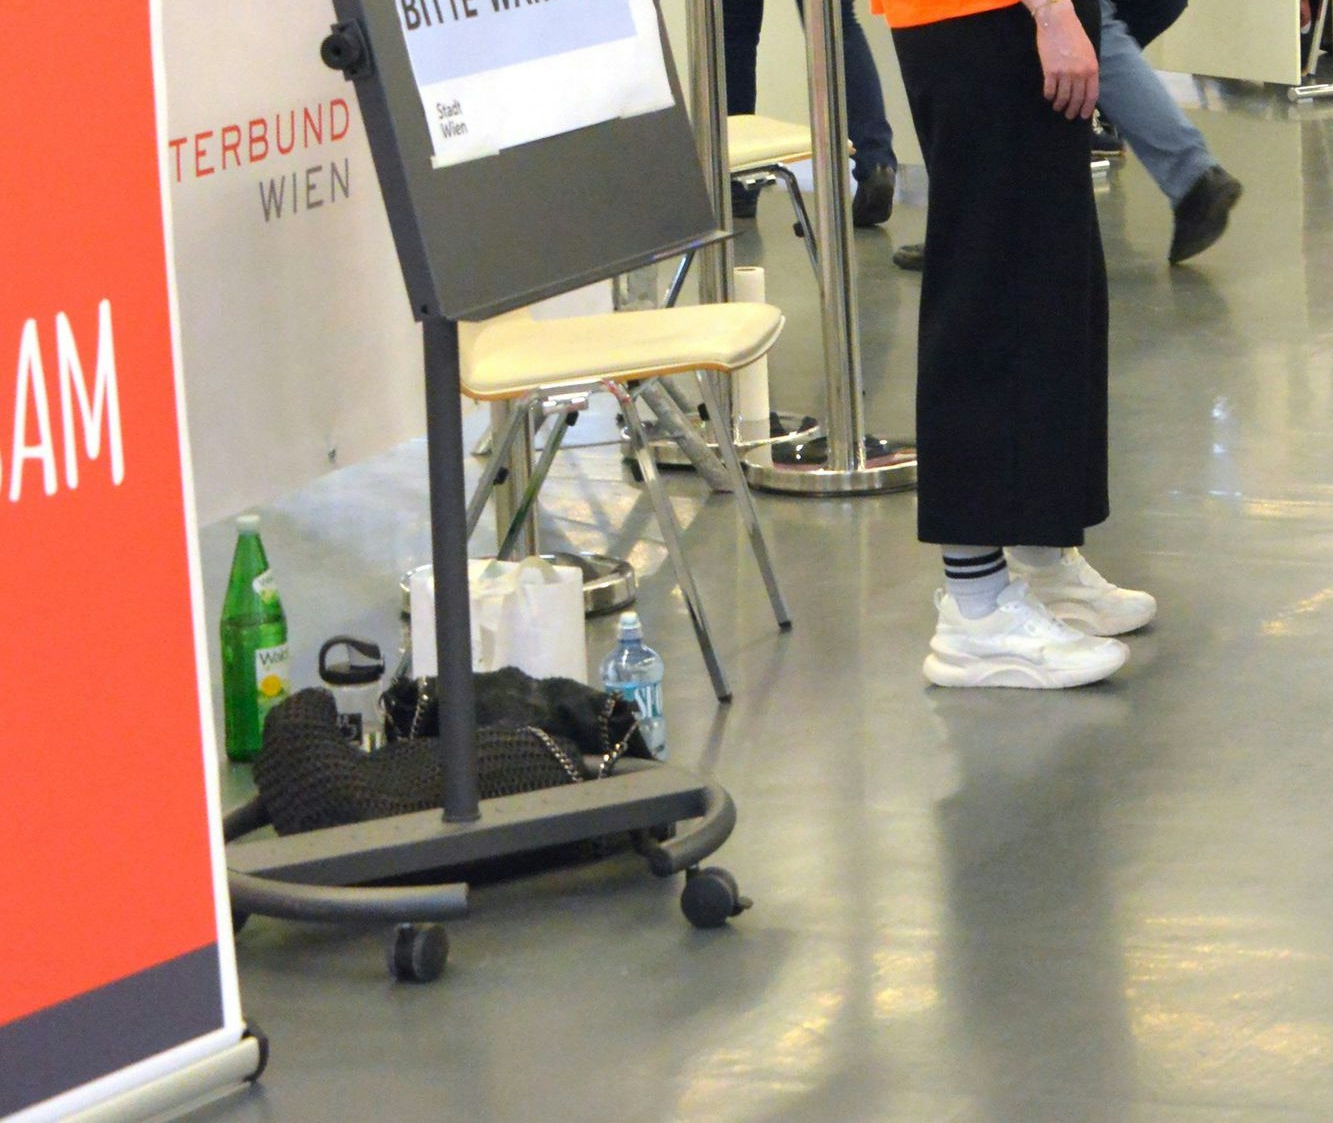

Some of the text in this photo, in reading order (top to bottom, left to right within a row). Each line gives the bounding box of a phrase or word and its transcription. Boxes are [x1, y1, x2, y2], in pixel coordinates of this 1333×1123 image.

[436, 99, 463, 119] Stadt
[440, 121, 468, 138] Wien
[259, 158, 350, 222] WIEN
[0, 298, 125, 503] AM
